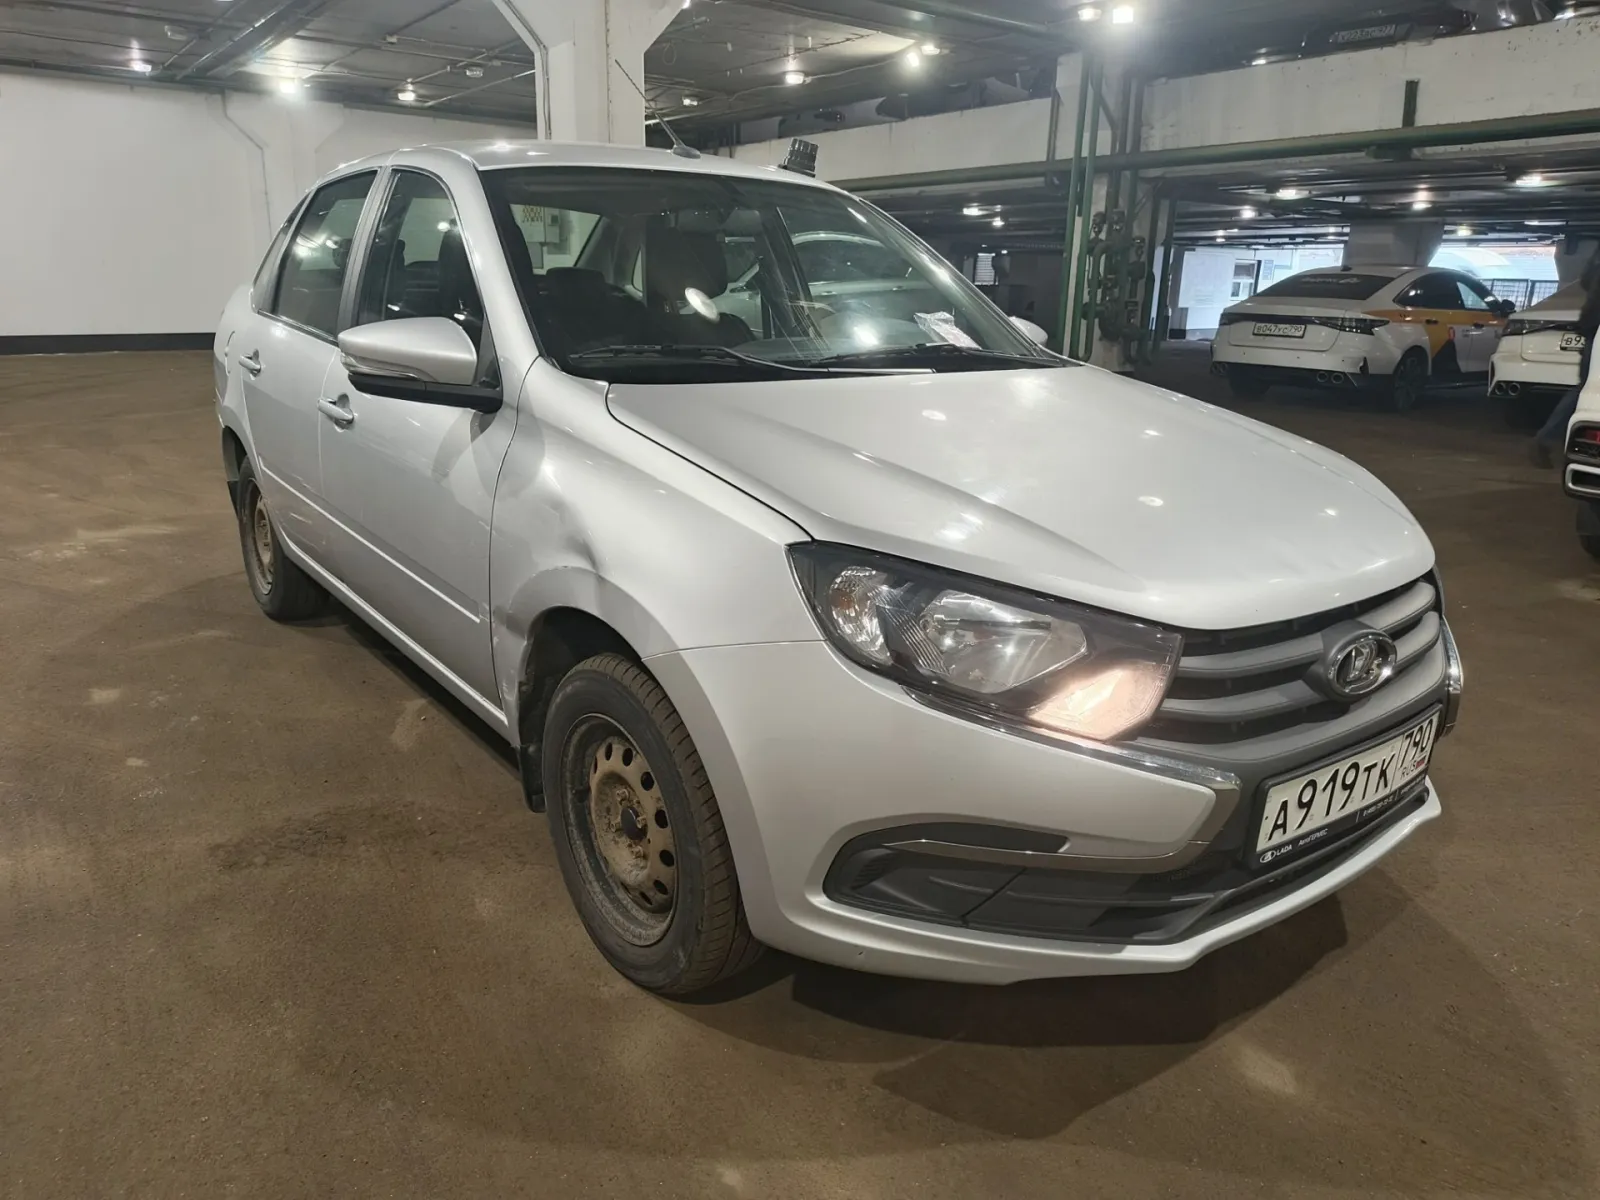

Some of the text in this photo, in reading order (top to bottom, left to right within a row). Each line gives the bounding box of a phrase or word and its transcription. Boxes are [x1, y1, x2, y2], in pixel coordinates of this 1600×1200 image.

[1400, 759, 1418, 779] RUS
[1267, 718, 1434, 842] А919ТК 790
[1276, 844, 1292, 856] LADA
